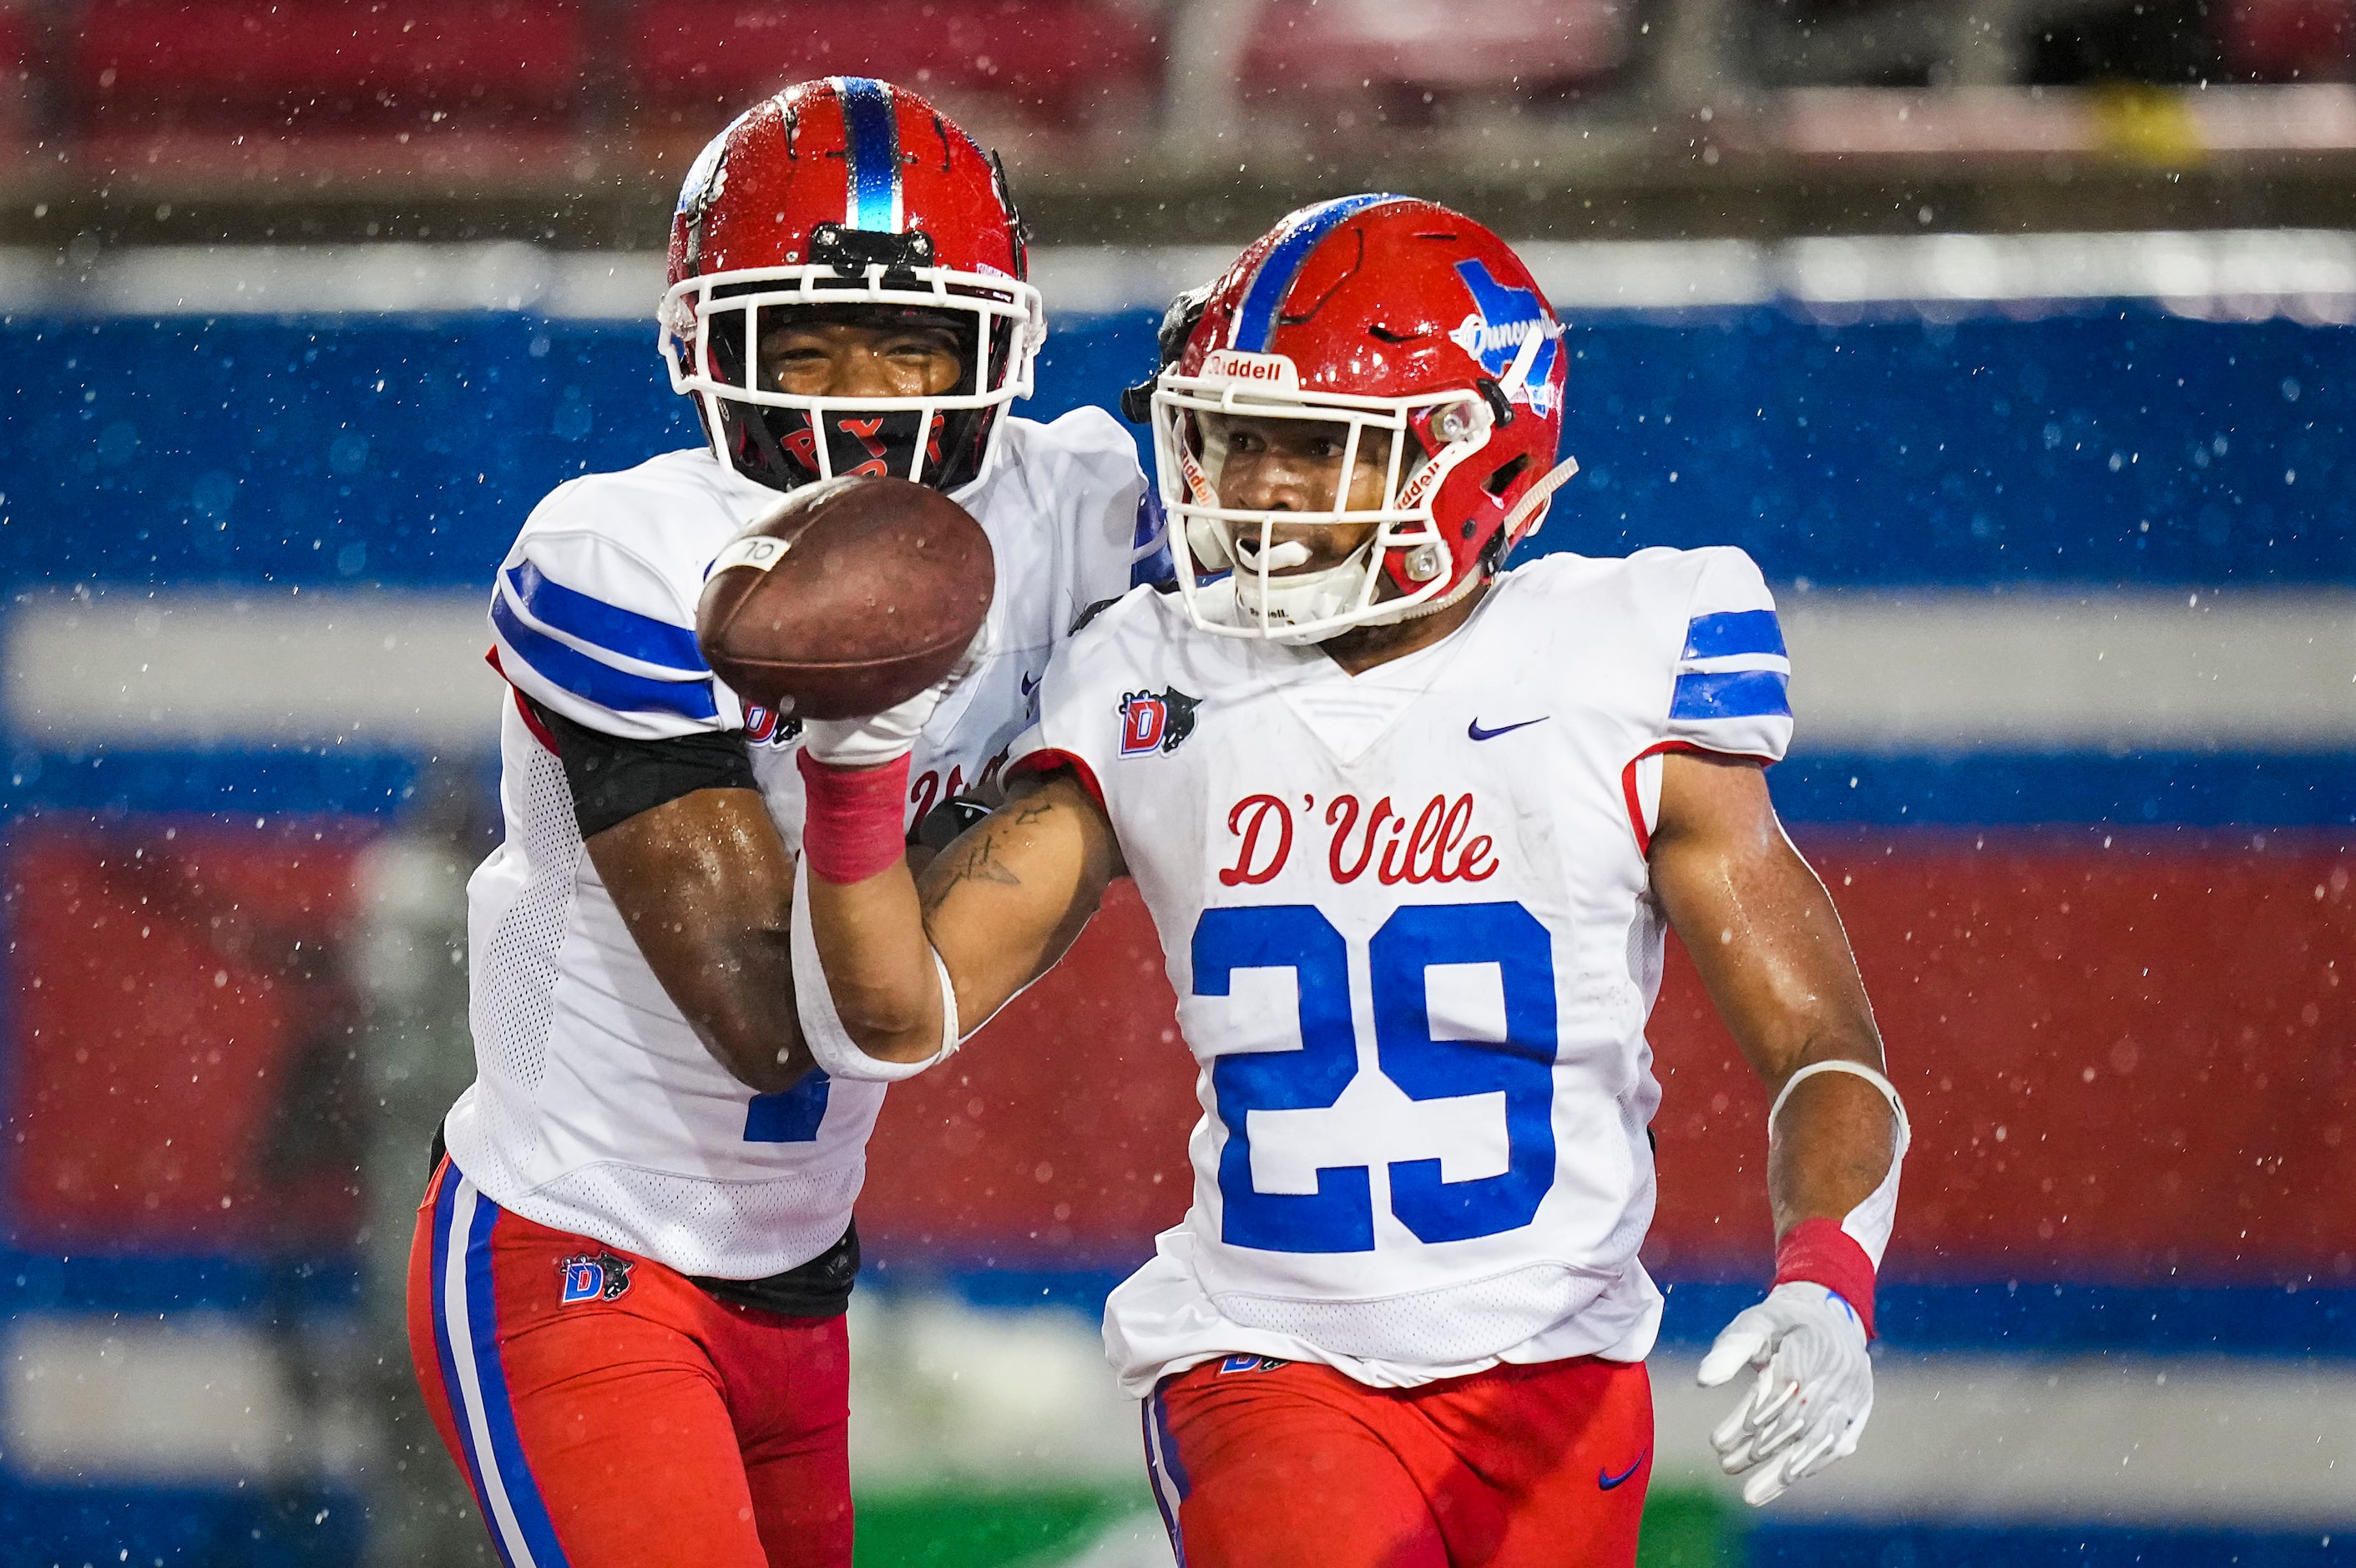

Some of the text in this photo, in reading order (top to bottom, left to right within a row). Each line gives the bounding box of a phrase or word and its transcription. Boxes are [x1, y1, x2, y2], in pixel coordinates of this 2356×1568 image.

[1208, 355, 1281, 381] Riddell
[1120, 696, 1168, 755] D
[1191, 900, 1558, 1254] 29
[562, 1262, 604, 1303] D
